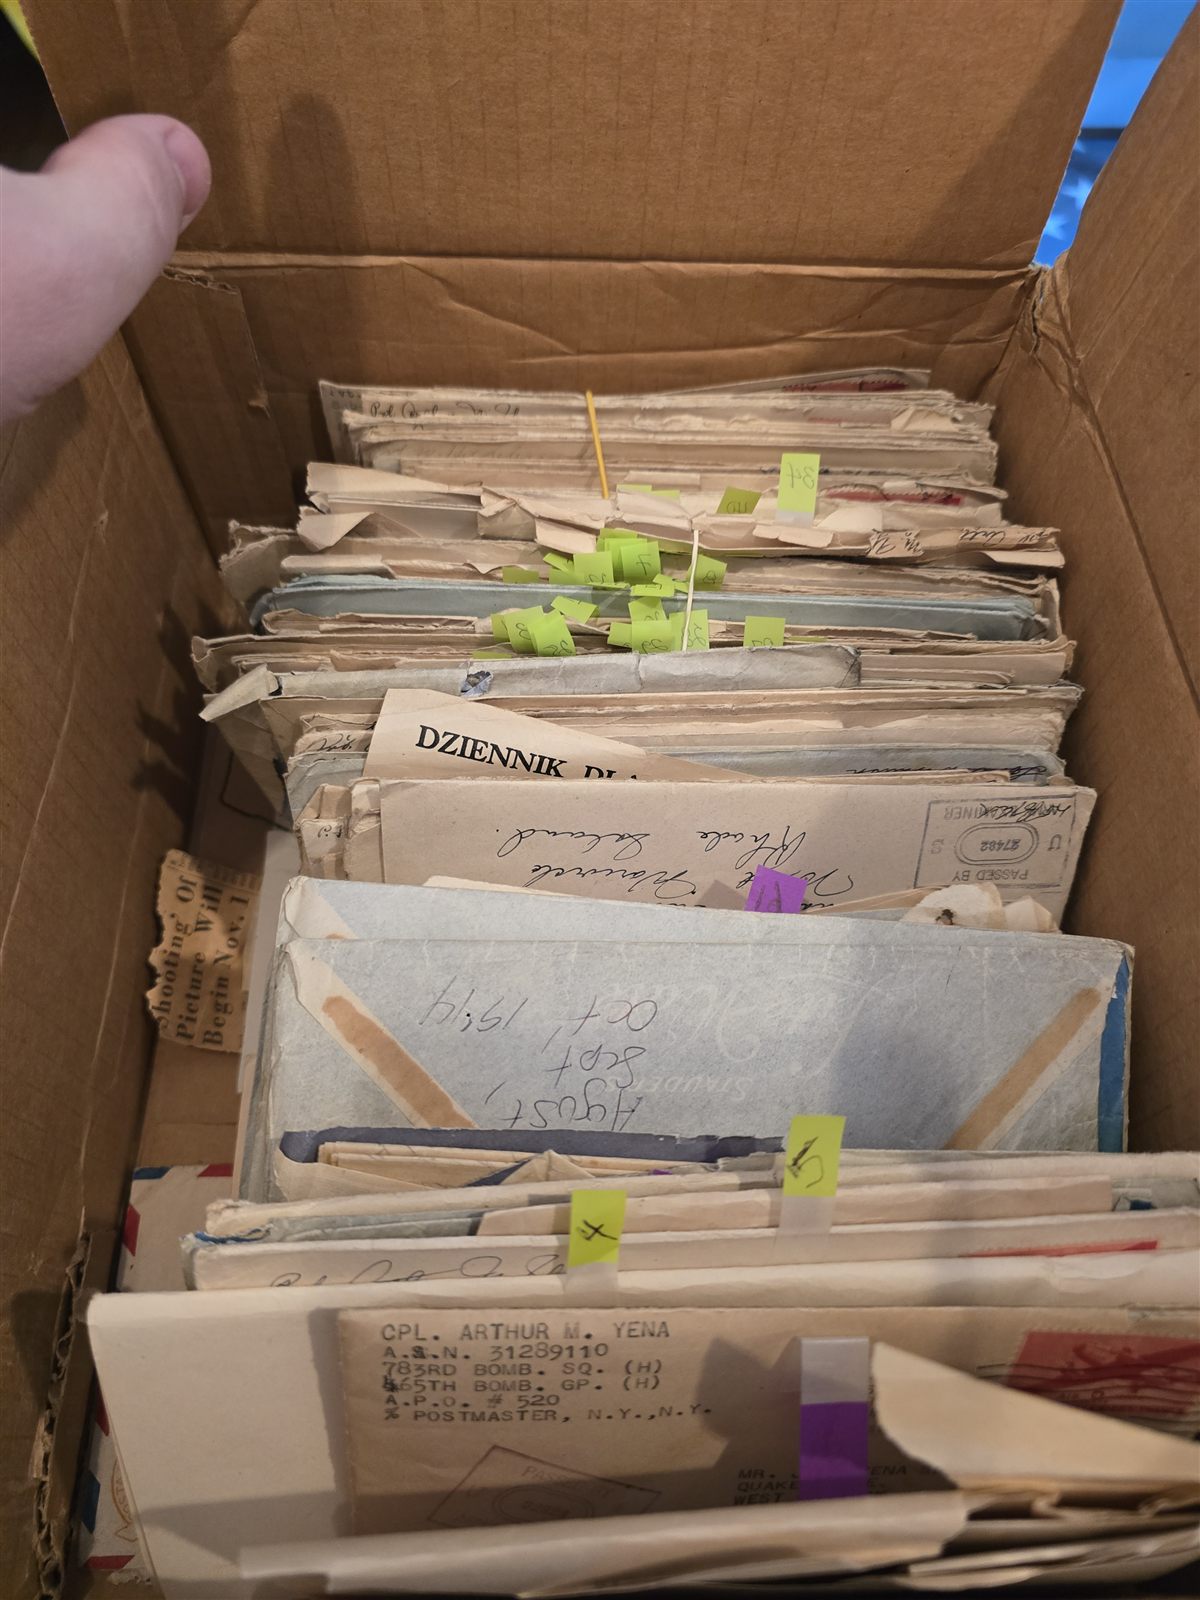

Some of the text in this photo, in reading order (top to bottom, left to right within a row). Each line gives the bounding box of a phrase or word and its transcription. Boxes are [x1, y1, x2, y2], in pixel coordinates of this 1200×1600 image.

[415, 724, 567, 778] DZIENNIK
[695, 826, 807, 877] Rhode
[951, 868, 1029, 882] PASSED BY
[175, 884, 223, 1041] Picture Will
[201, 975, 233, 1046] Begin
[381, 1320, 671, 1342] CPL. ARTHUR M. YENA
[489, 1342, 609, 1361] 31289110
[383, 1358, 663, 1378] 783RD BOMB. SQ. (H)
[474, 1379, 545, 1394] BOMB.
[561, 1378, 603, 1393] GP.
[622, 1374, 661, 1392] (H)
[384, 1393, 560, 1409] A.P.O. # 520
[413, 1407, 571, 1424] POSTMASTER,
[737, 1467, 777, 1480] MR.
[868, 1464, 908, 1477] ENA
[736, 1479, 800, 1493] QUAKE
[733, 1492, 783, 1506] WEST
